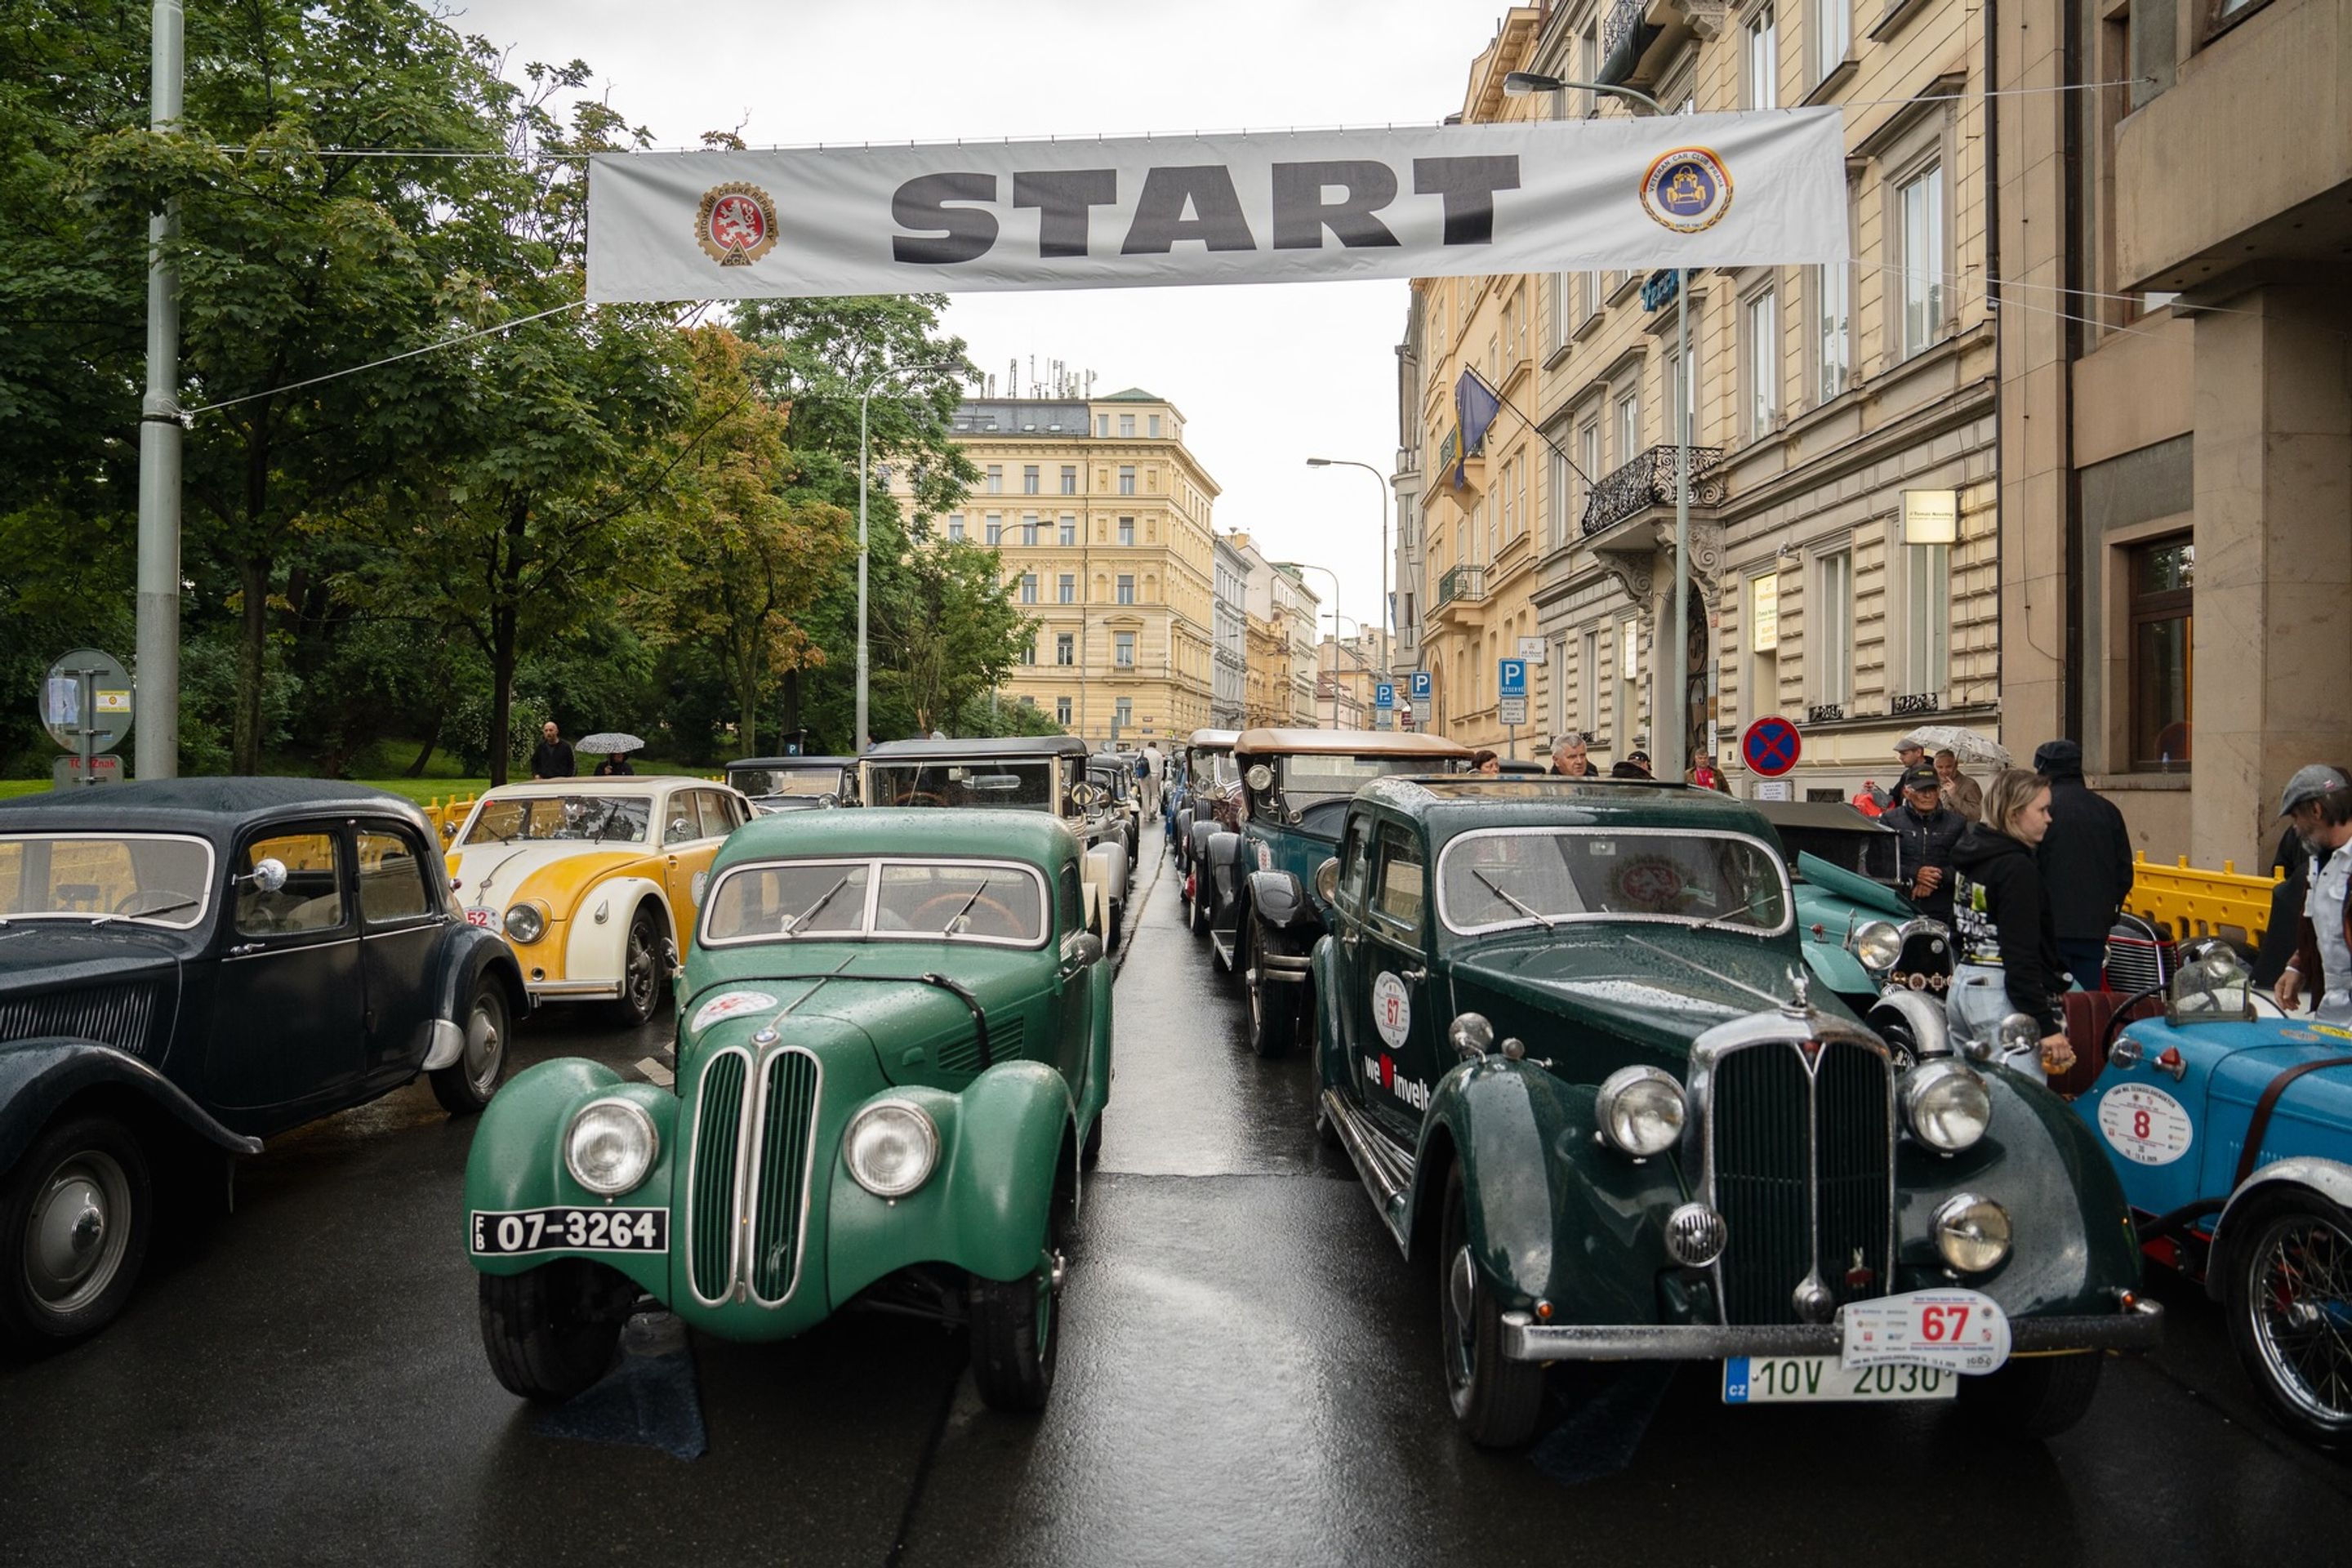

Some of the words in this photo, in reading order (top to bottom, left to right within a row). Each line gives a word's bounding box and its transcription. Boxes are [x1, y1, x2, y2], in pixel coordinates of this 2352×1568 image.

[1648, 161, 1671, 192] VETERAN
[1673, 153, 1688, 162] CAR
[1691, 153, 1710, 165] CLUB
[700, 196, 716, 242] AUTOKLUB
[751, 192, 775, 241] REPUBLIKY
[892, 154, 1521, 263] START
[1416, 675, 1428, 692] P
[1505, 664, 1521, 685] P
[1379, 687, 1390, 701] P
[467, 911, 488, 926] 52
[1387, 998, 1399, 1026] 67
[1365, 1055, 1381, 1085] we
[2134, 1110, 2150, 1139] 8
[497, 1211, 657, 1251] 07-3264
[1922, 1307, 1969, 1341] 67
[1729, 1385, 1746, 1396] CZ
[1761, 1361, 1823, 1396] 10V
